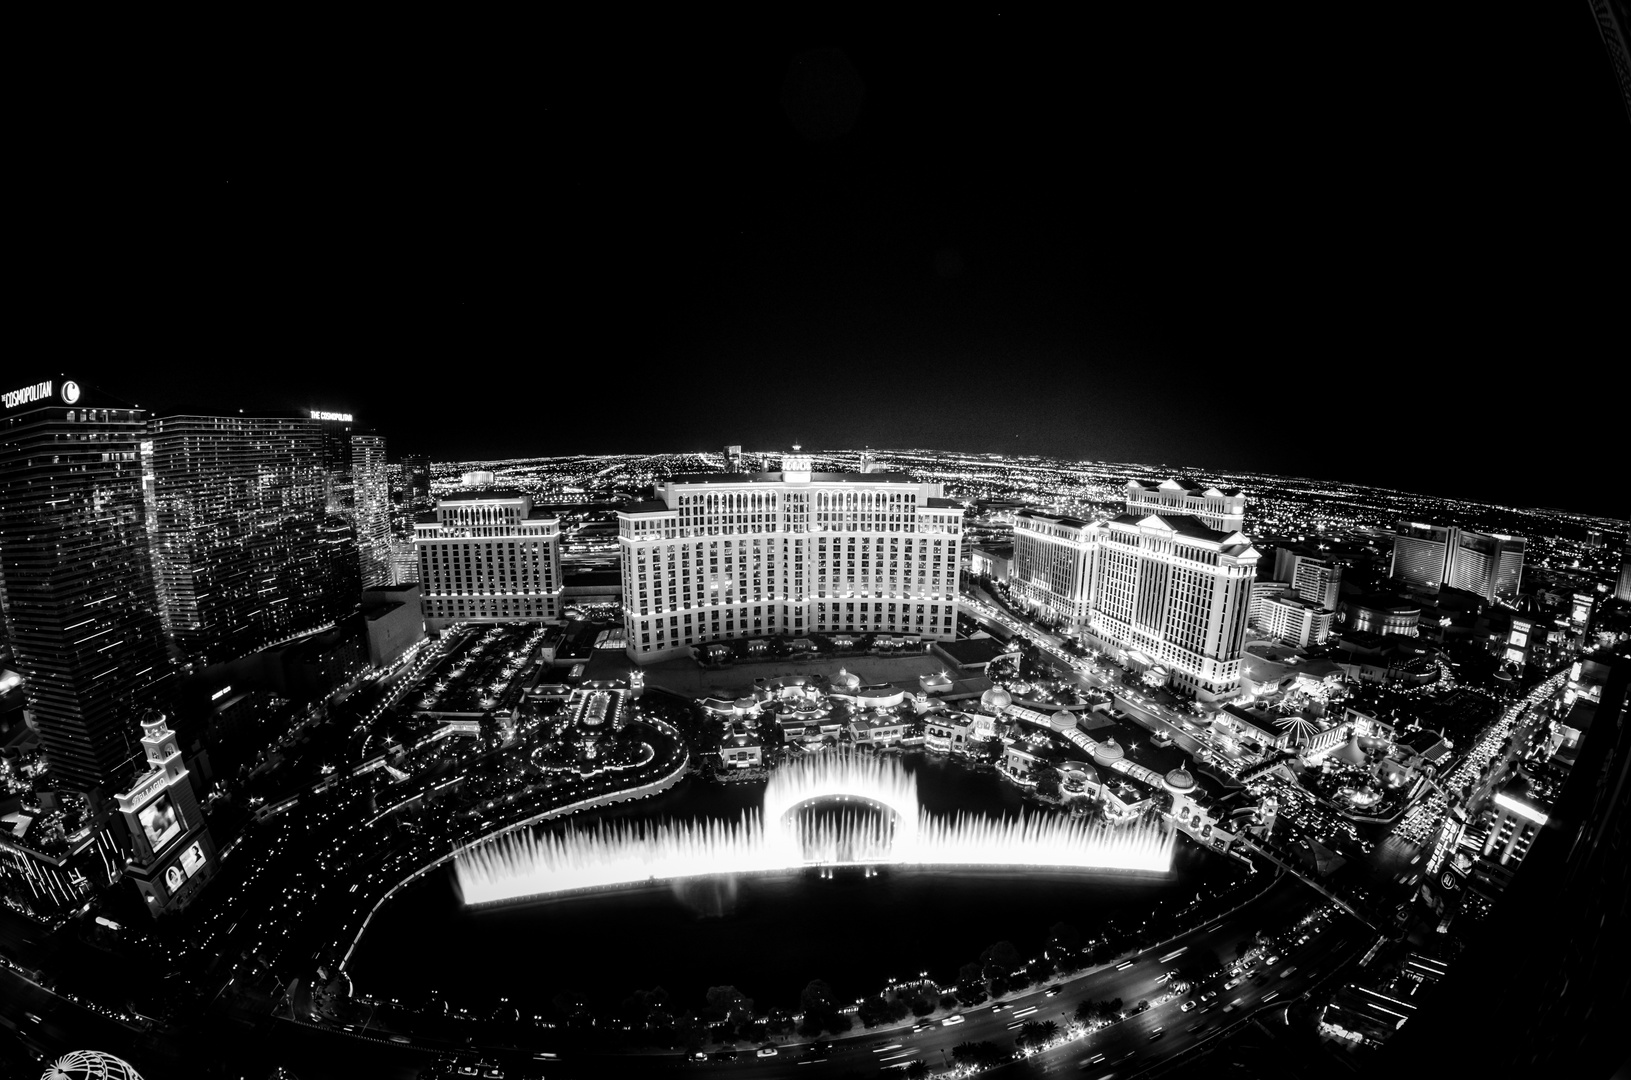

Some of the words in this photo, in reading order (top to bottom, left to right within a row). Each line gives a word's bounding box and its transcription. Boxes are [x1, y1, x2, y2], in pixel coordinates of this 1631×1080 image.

[5, 380, 52, 408] COSMOPOLITAN
[310, 411, 320, 419] THE
[321, 411, 352, 421] COSMOPOLITAN
[131, 777, 165, 807] BELLAGIO
